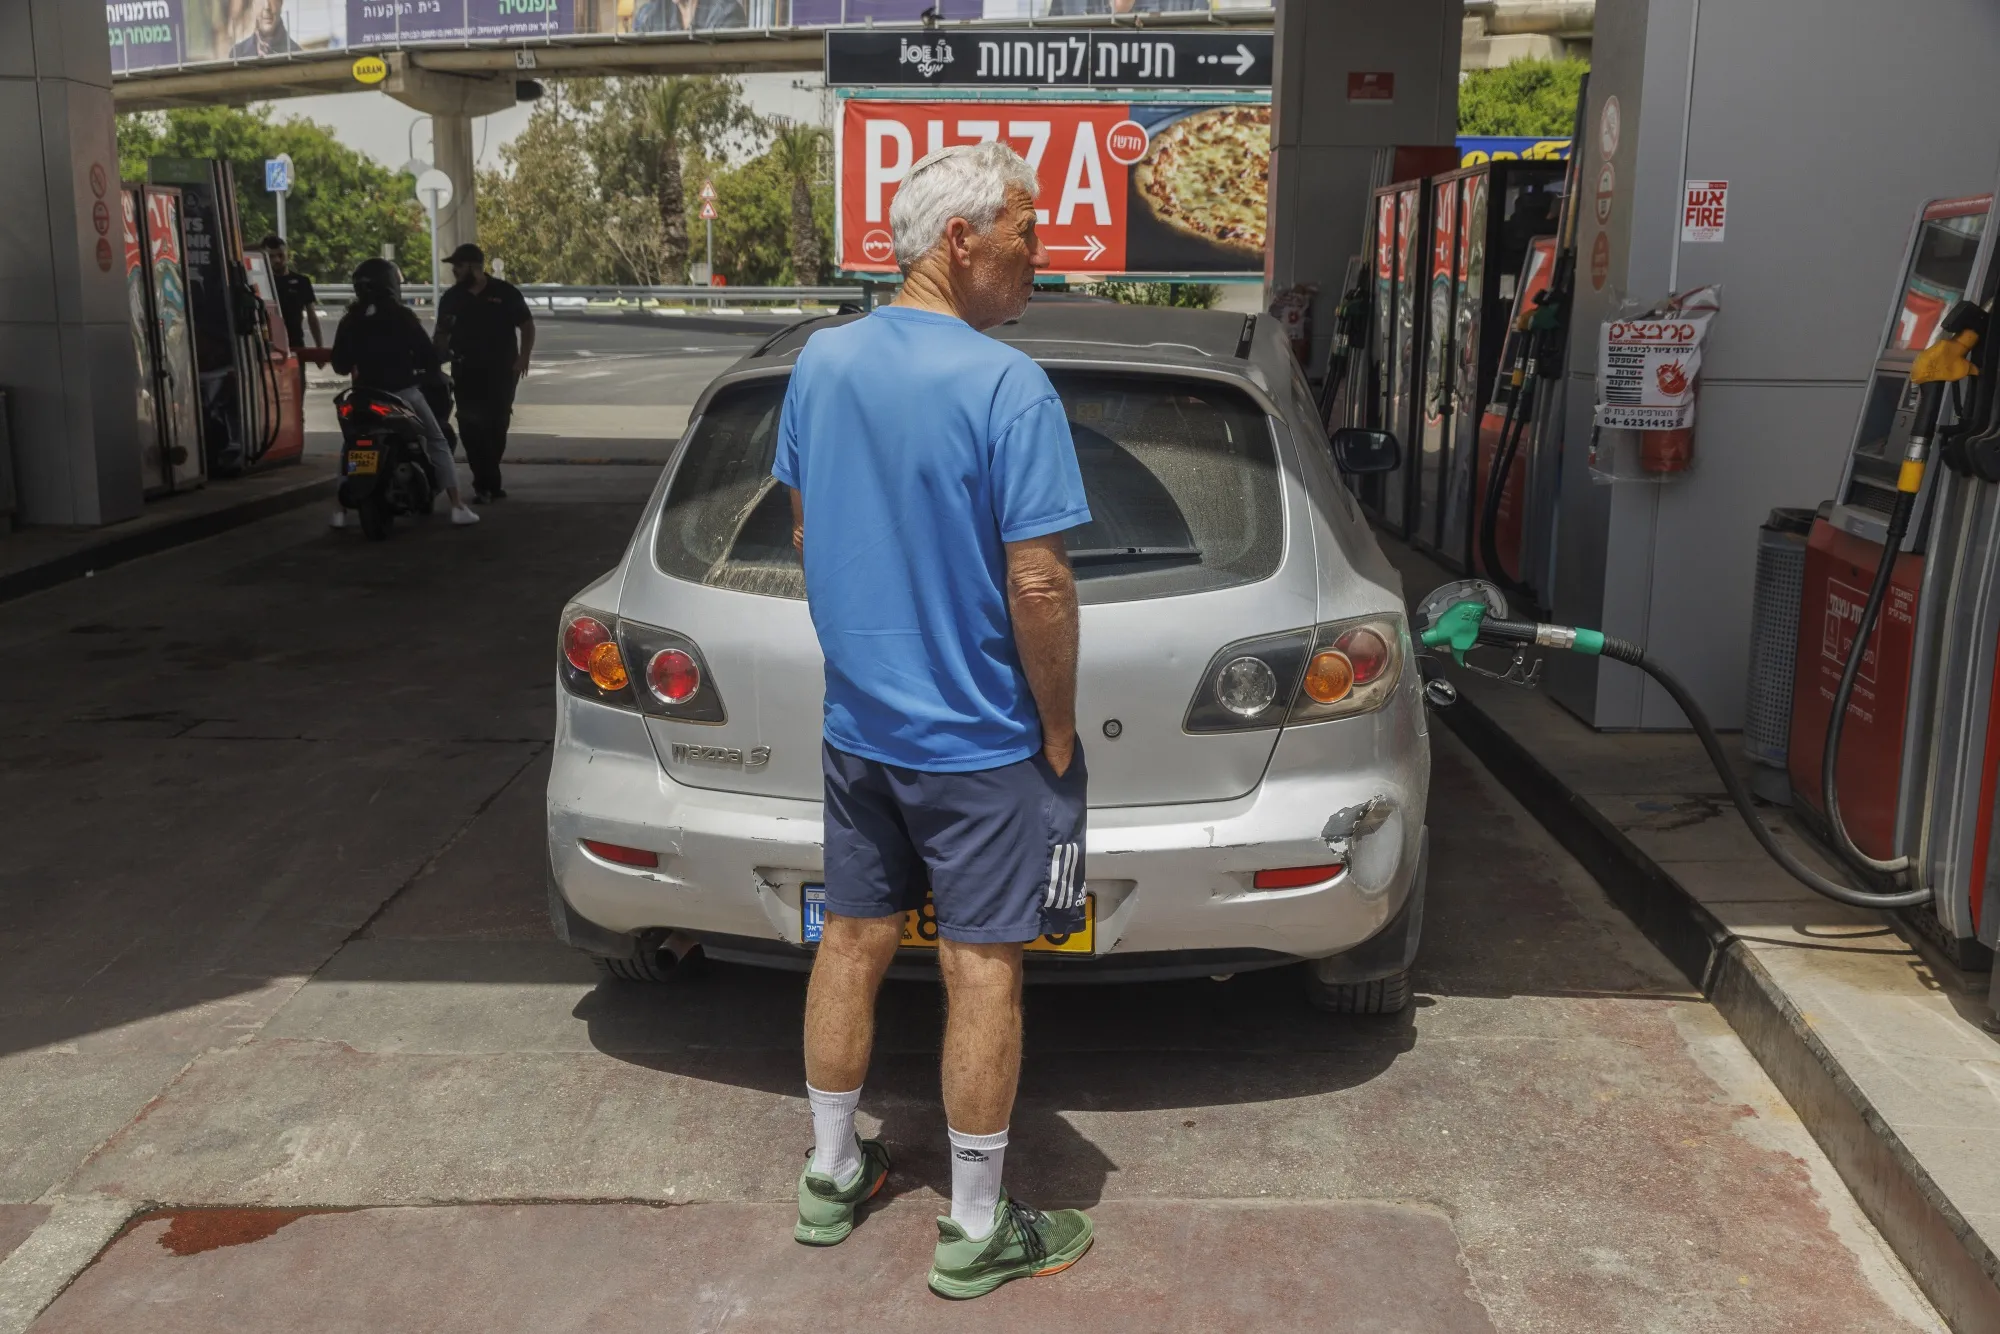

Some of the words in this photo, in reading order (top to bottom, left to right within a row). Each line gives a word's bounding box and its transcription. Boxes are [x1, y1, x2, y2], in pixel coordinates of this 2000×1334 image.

[106, 0, 170, 23] הזדמנויות
[418, 0, 441, 13] בית
[125, 24, 172, 45] במסחר
[976, 37, 1087, 83] לקוחות
[1095, 42, 1175, 77] חניית
[356, 65, 384, 76] BARAM
[1113, 134, 1142, 151] חדש!
[865, 119, 1112, 225] PZA
[1688, 190, 1724, 206] אש
[1685, 207, 1724, 227] FIRE
[1653, 346, 1671, 354] ציוד
[1608, 356, 1638, 364] אספקה
[1615, 368, 1637, 376] שרות
[1608, 379, 1636, 387] התקנה
[1604, 417, 1674, 427] 04-6231415
[744, 745, 771, 767] 3
[810, 903, 825, 925] IL
[806, 924, 823, 932] ראל
[956, 1153, 990, 1162] adidas
